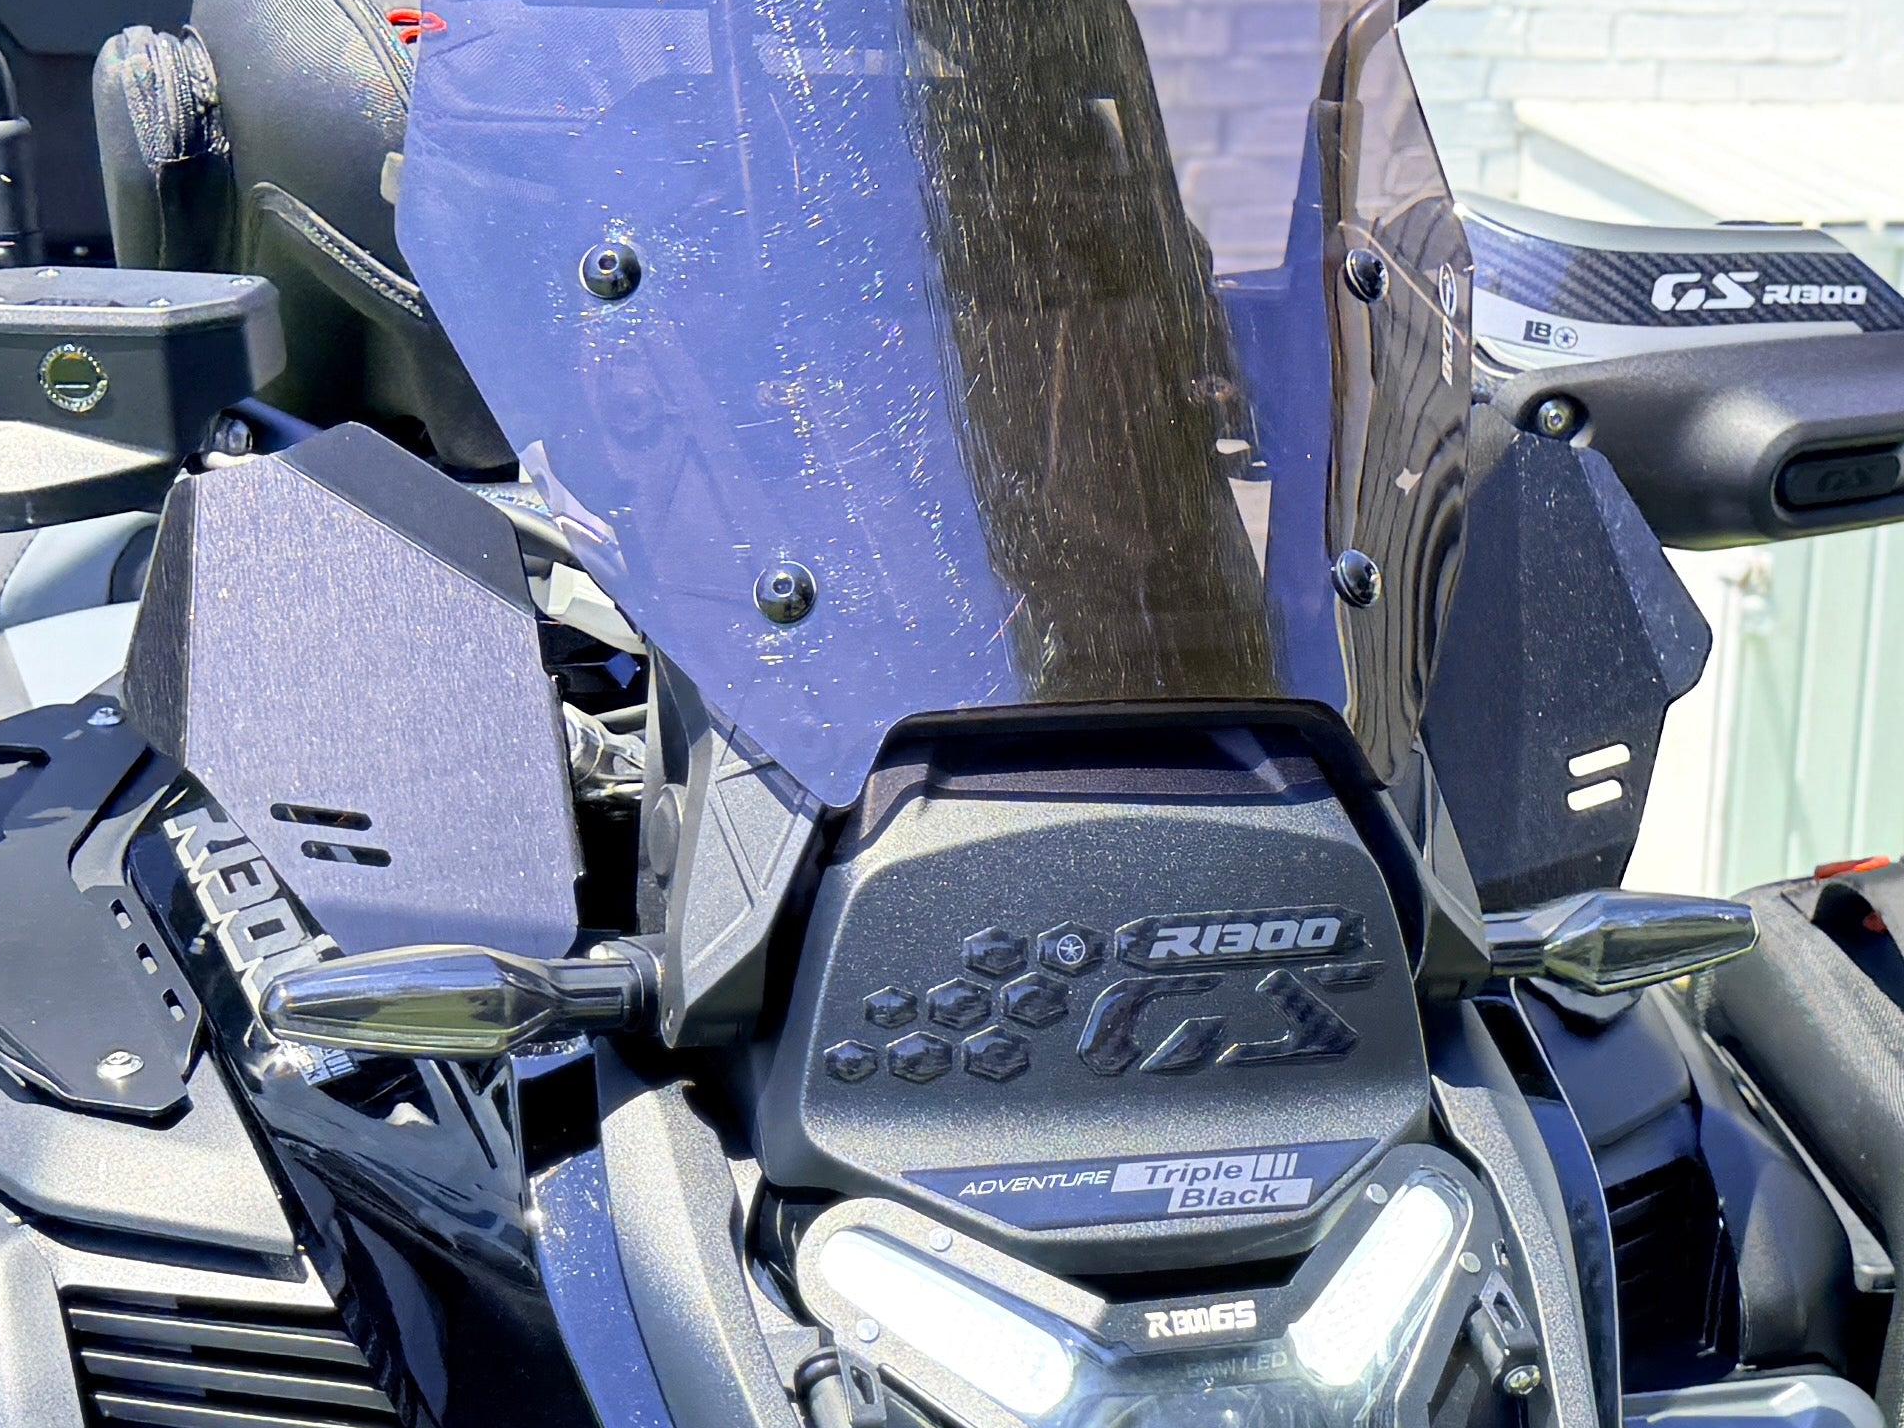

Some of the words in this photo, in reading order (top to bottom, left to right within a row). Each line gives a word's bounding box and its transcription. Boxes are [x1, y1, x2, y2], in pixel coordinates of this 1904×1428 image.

[1651, 270, 1759, 312] GS
[1762, 284, 1868, 306] R1300
[1149, 917, 1342, 959] R1300
[1076, 960, 1386, 1076] GS
[958, 1170, 1112, 1198] ADVENTURE
[1144, 1160, 1244, 1187] Triple
[1178, 1183, 1282, 1209] Black
[1240, 1350, 1289, 1372] LED
